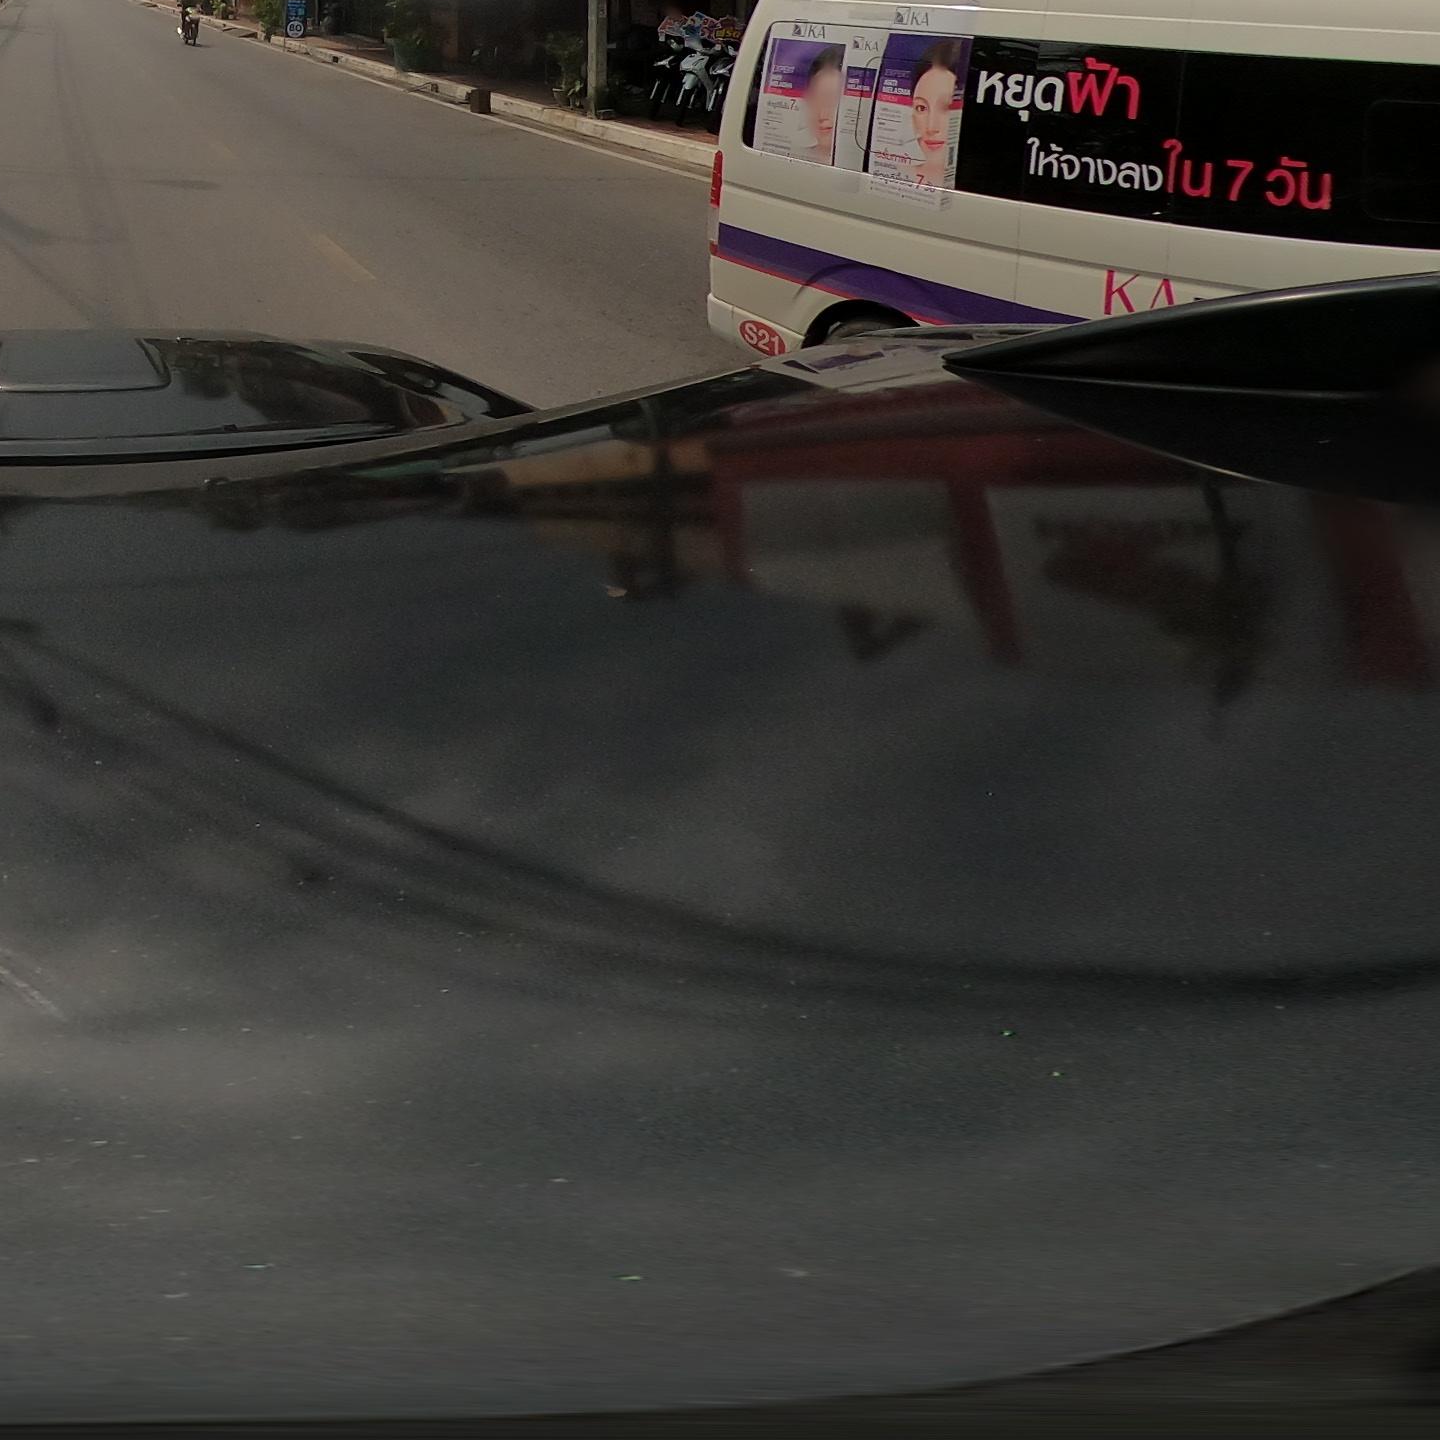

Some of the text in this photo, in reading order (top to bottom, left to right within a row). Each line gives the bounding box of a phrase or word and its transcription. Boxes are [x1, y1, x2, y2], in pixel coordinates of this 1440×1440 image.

[806, 25, 826, 39] KA
[910, 11, 929, 27] KA
[975, 56, 1141, 122] หยุดฝ้า
[1027, 137, 1332, 211] ให้จางลงใน 7 วัน
[744, 322, 780, 355] S21
